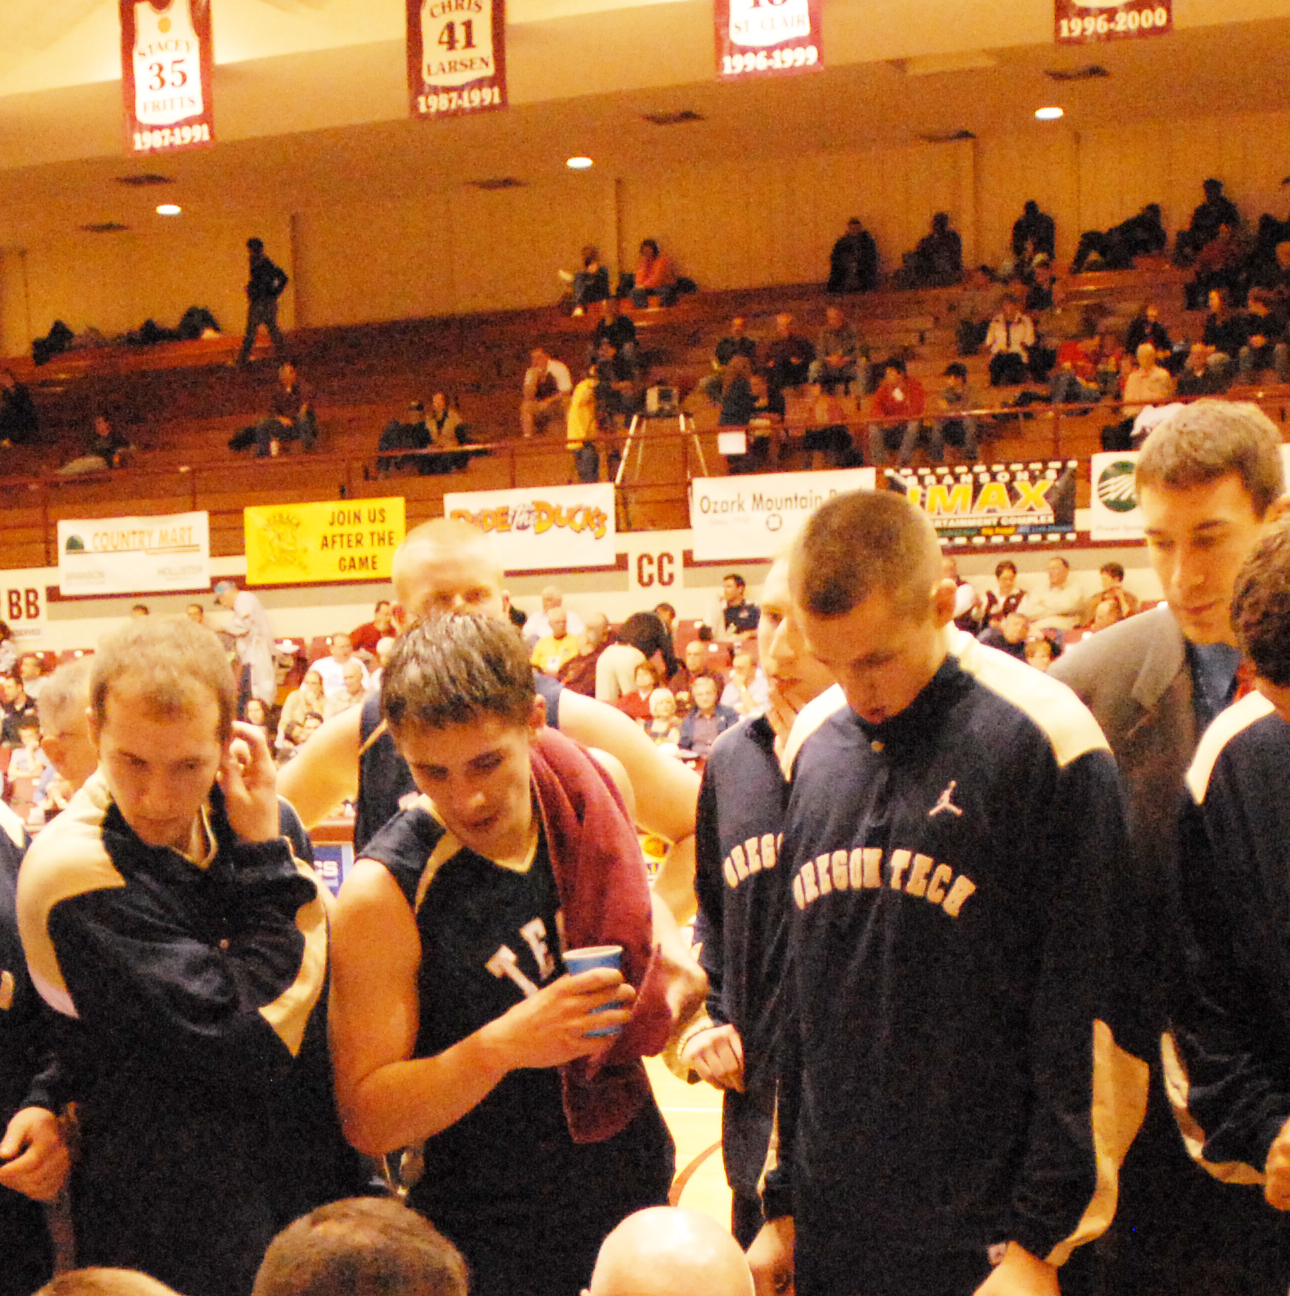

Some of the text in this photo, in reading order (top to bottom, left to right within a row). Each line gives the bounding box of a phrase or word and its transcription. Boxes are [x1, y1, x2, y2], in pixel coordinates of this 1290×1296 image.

[430, 0, 482, 19] CHRIS
[759, 13, 810, 34] CLAIR
[1058, 7, 1168, 37] 1996-2000
[437, 18, 477, 52] 41
[137, 39, 197, 61] STACEY
[721, 45, 819, 75] 1996-1999
[147, 59, 188, 92] 35
[426, 55, 491, 77] LARSEN
[143, 96, 197, 114] FRITTS
[416, 85, 502, 114] 1987-1991
[132, 123, 209, 151] 1987-1991
[700, 493, 746, 514] Ozark
[751, 489, 824, 513] Mountain
[907, 479, 1055, 516] IMAX
[329, 507, 387, 527] JOIN US
[531, 499, 609, 540] DUCKS
[1000, 514, 1055, 526] COMPLEX
[91, 525, 194, 552] COUNTRY MART
[320, 531, 396, 552] AFTER THE
[338, 555, 378, 573] GAME
[636, 552, 675, 589] CC
[7, 588, 41, 622] BB
[723, 832, 784, 889] OREG
[793, 847, 978, 918] OREGON TECH
